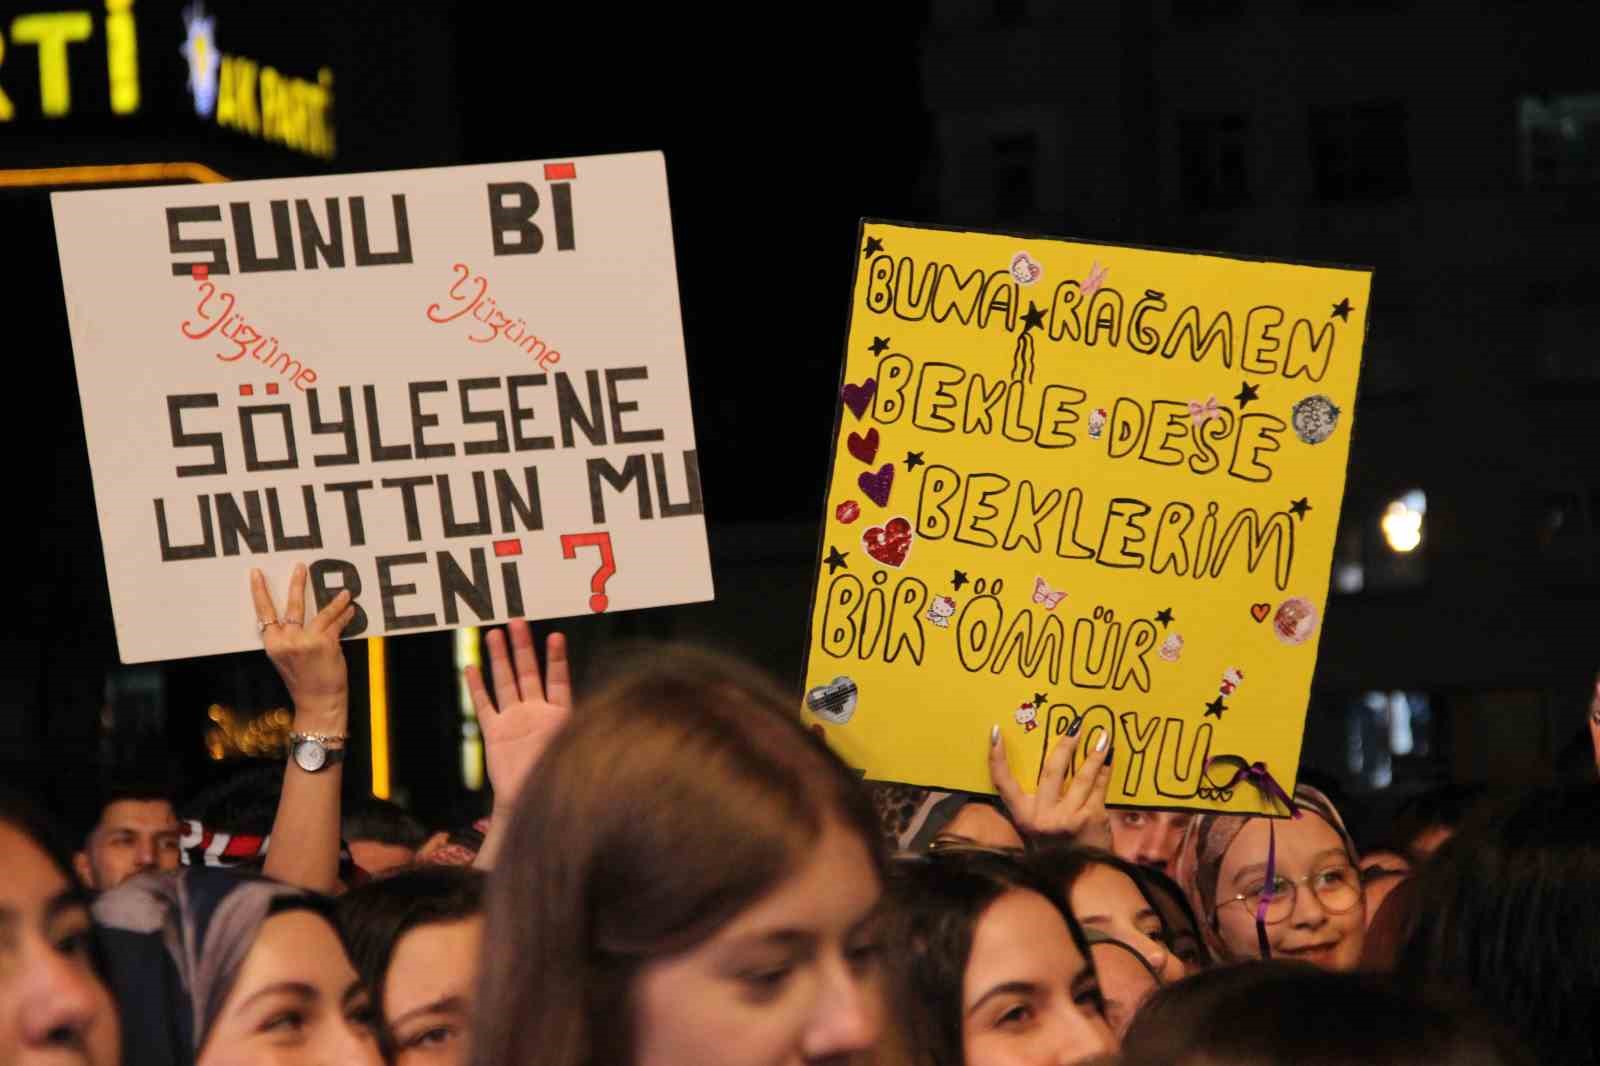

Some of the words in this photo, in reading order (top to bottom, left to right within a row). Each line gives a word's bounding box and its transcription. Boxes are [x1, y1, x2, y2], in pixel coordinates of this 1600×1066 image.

[0, 0, 139, 121] Tİ
[487, 161, 576, 256] Bİ
[181, 281, 317, 391] Yüzüme
[426, 263, 560, 371] Yüzüme
[866, 255, 1019, 332] BUNA
[1048, 280, 1335, 382] RAĞMEN
[166, 366, 664, 478] SÖYLESENE
[871, 353, 1087, 448] BEKLE
[1107, 397, 1287, 482] DESE
[153, 465, 544, 562] UNUTTUN
[586, 449, 704, 524] MU
[916, 464, 1294, 591] BEKLERİM
[309, 538, 525, 639] BENİ
[560, 531, 616, 613] ?
[821, 570, 928, 666] BİR
[956, 578, 1157, 693] ÖMÜR
